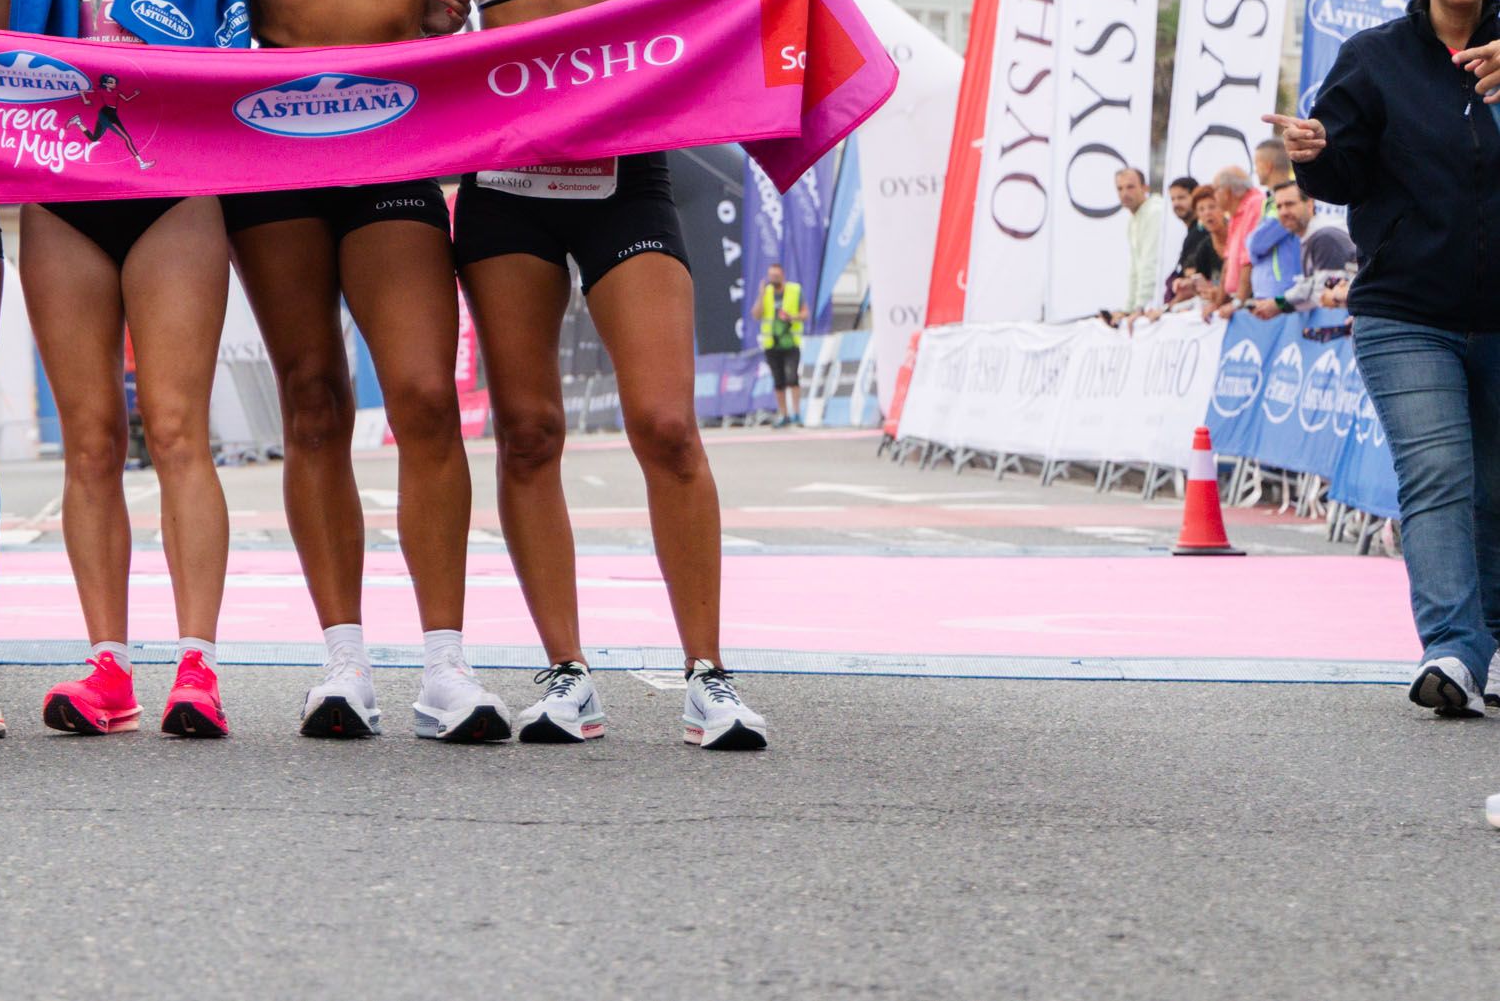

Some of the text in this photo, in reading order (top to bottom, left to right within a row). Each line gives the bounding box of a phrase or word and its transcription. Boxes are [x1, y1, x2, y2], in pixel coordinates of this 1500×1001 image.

[134, 2, 189, 38] ASTURIANA
[487, 34, 685, 97] OYSHO
[247, 91, 405, 120] ASTURIANA
[0, 129, 16, 149] la
[14, 128, 101, 174] Mujer
[558, 182, 601, 192] Santander
[375, 198, 425, 210] OYSHO
